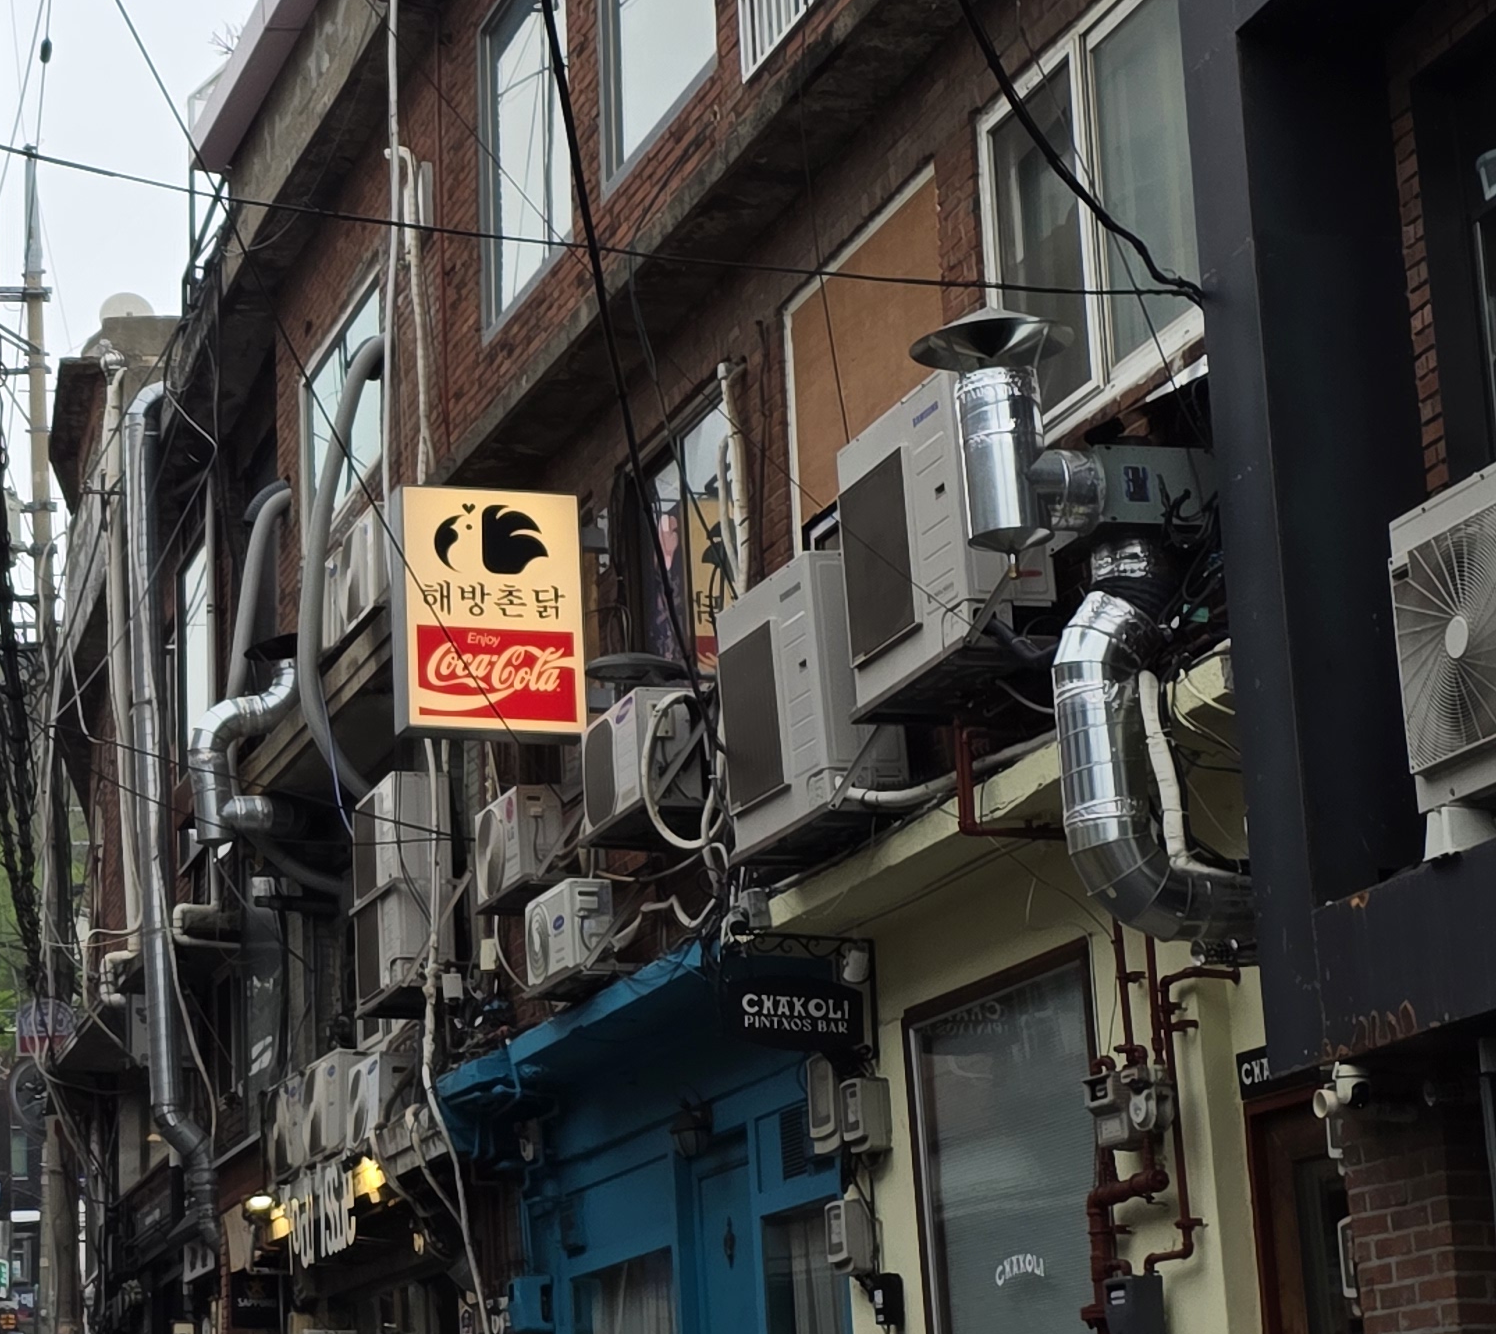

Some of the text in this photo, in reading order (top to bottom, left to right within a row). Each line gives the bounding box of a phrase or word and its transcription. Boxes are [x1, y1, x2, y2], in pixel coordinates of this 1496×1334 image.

[422, 579, 566, 620] 해방촌닭
[467, 632, 501, 648] Enjoy
[427, 641, 565, 692] Coca-Cola
[741, 993, 849, 1019] CHAKOLI
[744, 1014, 848, 1034] PINTXOS BAR
[994, 1253, 1045, 1286] CHAKOLI
